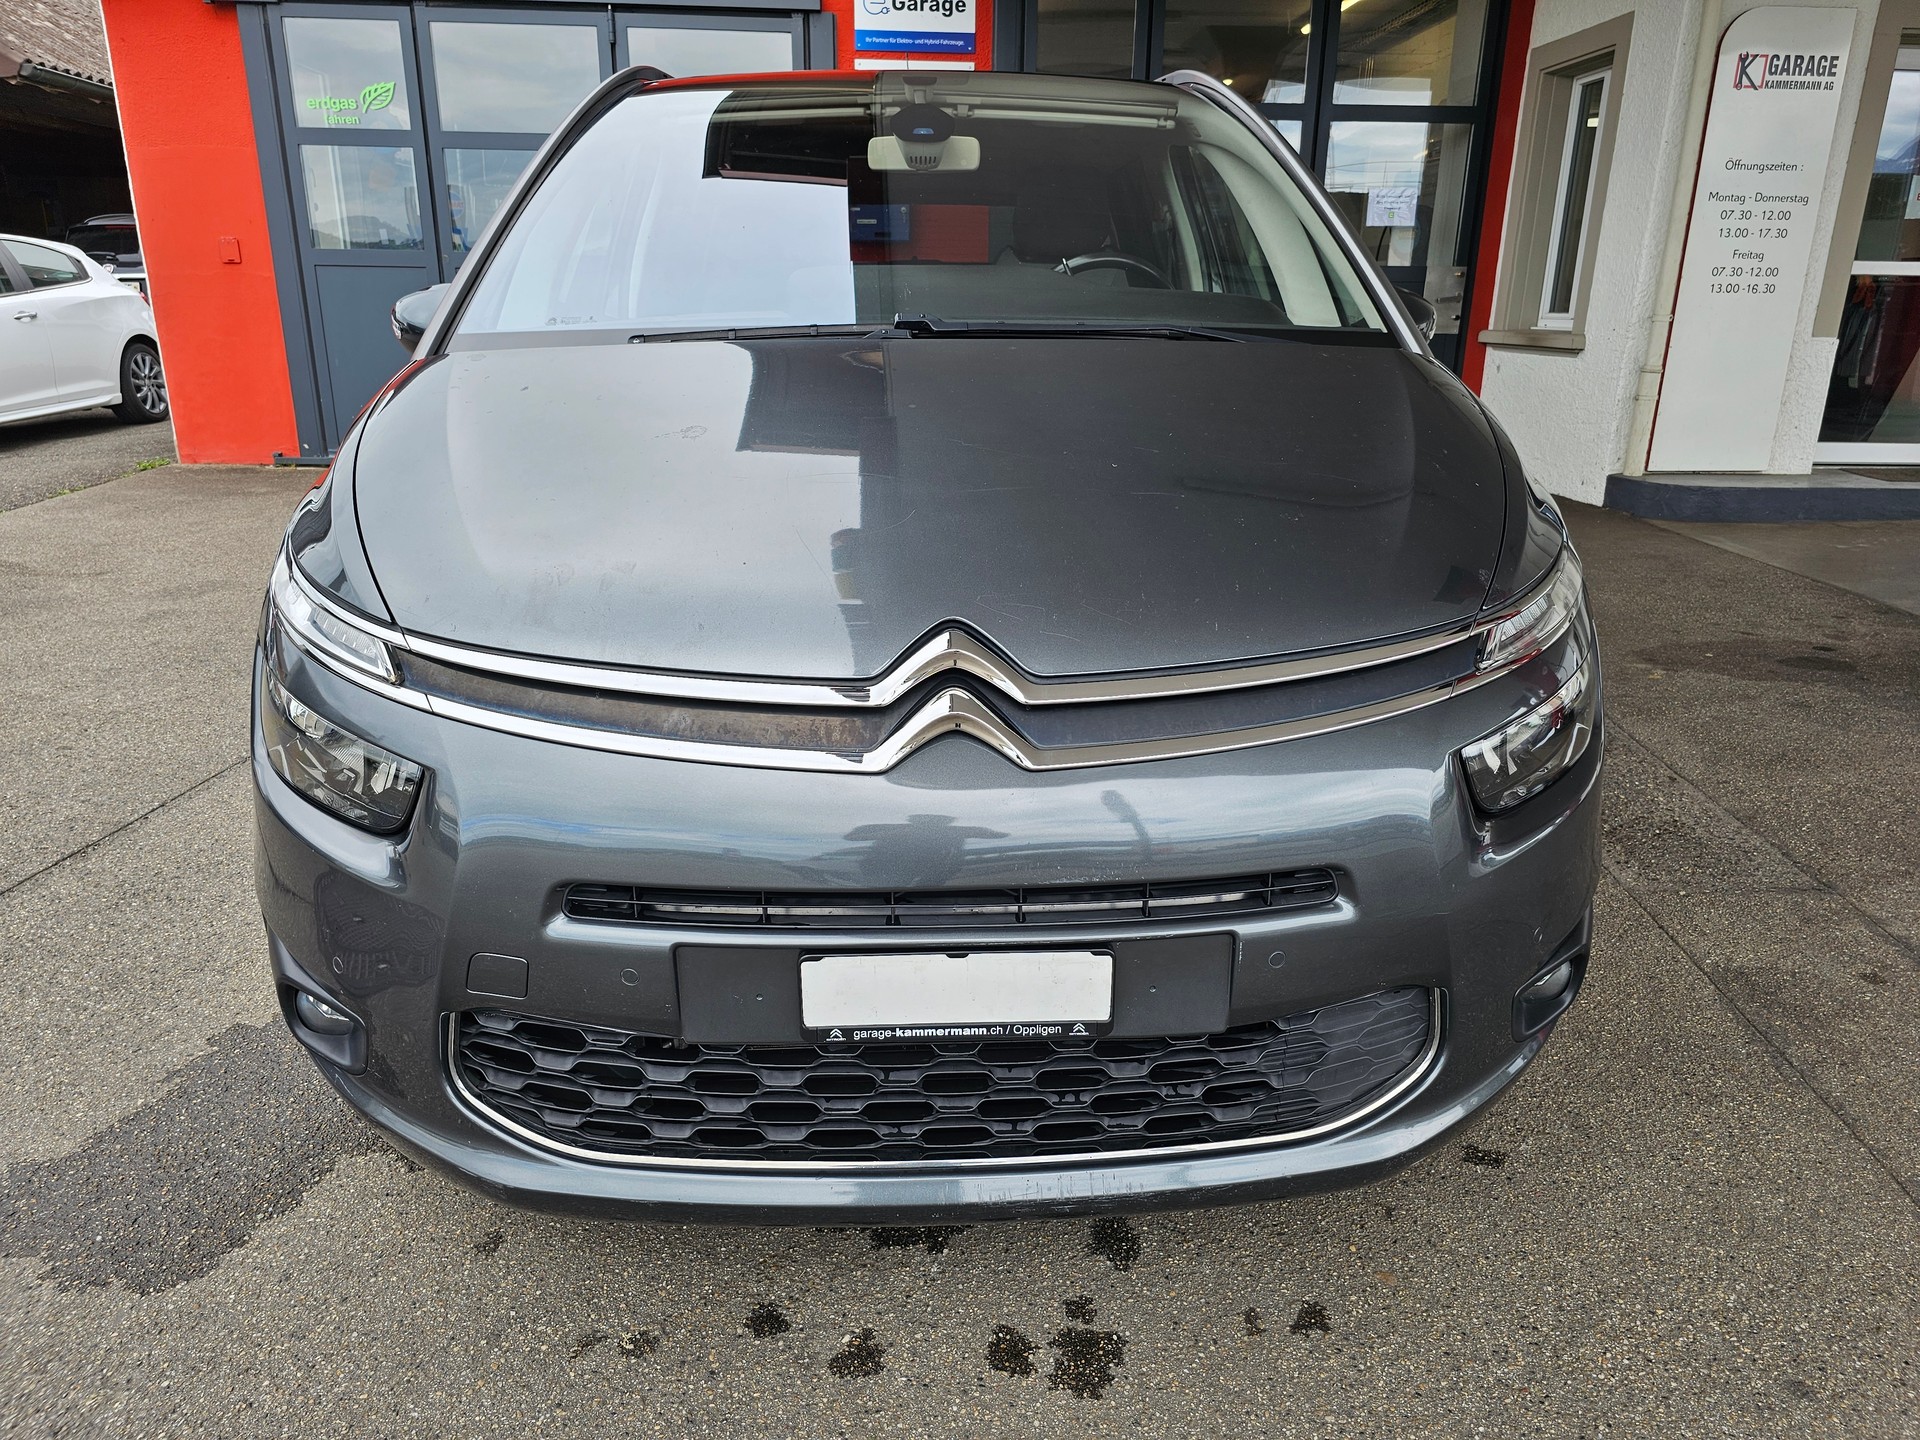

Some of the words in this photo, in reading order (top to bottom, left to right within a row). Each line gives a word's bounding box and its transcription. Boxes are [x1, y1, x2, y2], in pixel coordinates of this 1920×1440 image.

[892, 0, 966, 17] Garage
[1768, 54, 1840, 77] GARAGE
[1764, 80, 1822, 90] KAMMERMANN
[1823, 81, 1834, 90] AG
[306, 96, 358, 112] erdgas
[1708, 191, 1746, 205] Montag
[1754, 192, 1809, 206] Donnerstag
[1720, 210, 1752, 220] 07.30
[1761, 210, 1791, 221] 12.00
[1719, 227, 1749, 238] 13.00
[1758, 228, 1788, 239] 17.30
[1732, 249, 1765, 263] Freitag
[1711, 266, 1743, 277] 07.30
[1710, 283, 1740, 294] 13.00
[853, 1026, 1003, 1040] garage-kammermann.ch
[1013, 1025, 1062, 1036] Oppligen
